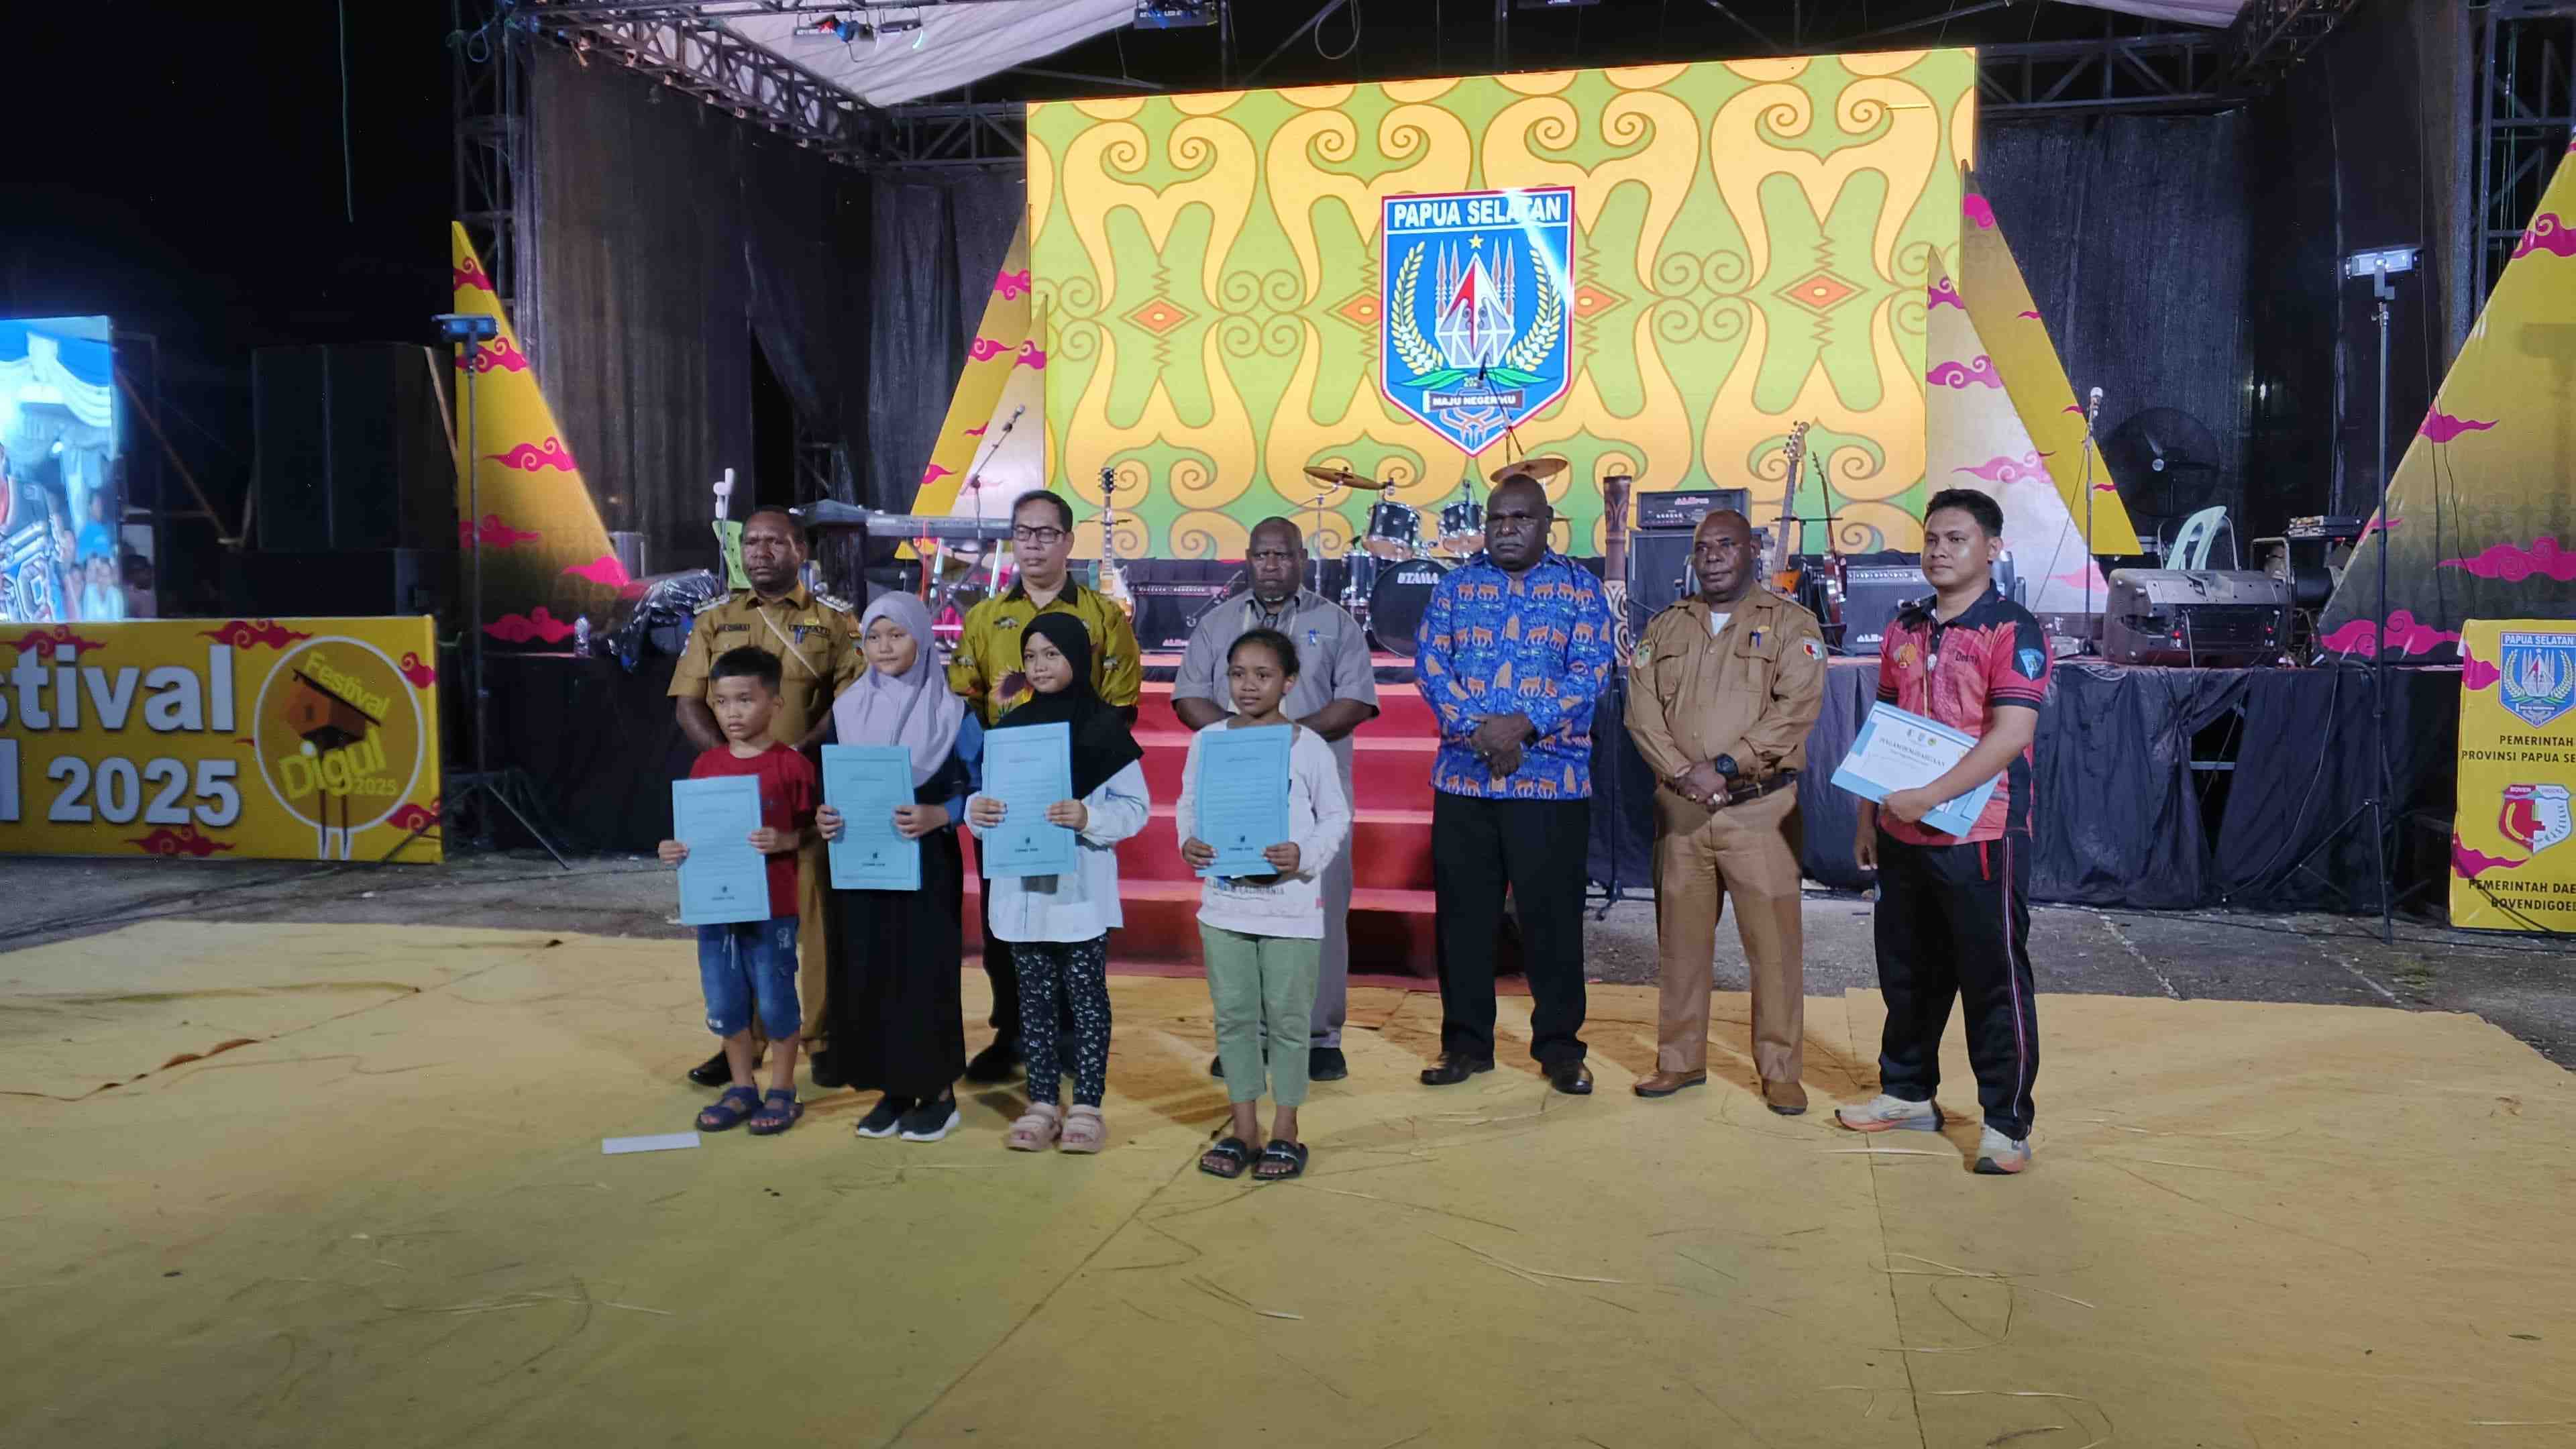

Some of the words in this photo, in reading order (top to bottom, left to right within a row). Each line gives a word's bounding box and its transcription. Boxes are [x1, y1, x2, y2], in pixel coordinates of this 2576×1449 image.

[1394, 201, 1461, 227] PAPUA
[1467, 197, 1560, 225] SELATAN
[2505, 635, 2533, 644] PAPUA
[2535, 636, 2573, 645] SELATAN
[0, 645, 234, 731] tival
[304, 651, 390, 720] Festival
[2500, 735, 2573, 746] PEMERINTAH
[278, 727, 386, 799] Digul
[2462, 751, 2515, 761] PROVINSI
[2522, 752, 2559, 762] PAPUA
[48, 756, 241, 826] 2025
[354, 777, 397, 795] 2025
[2469, 879, 2547, 892] PEMERINTAH
